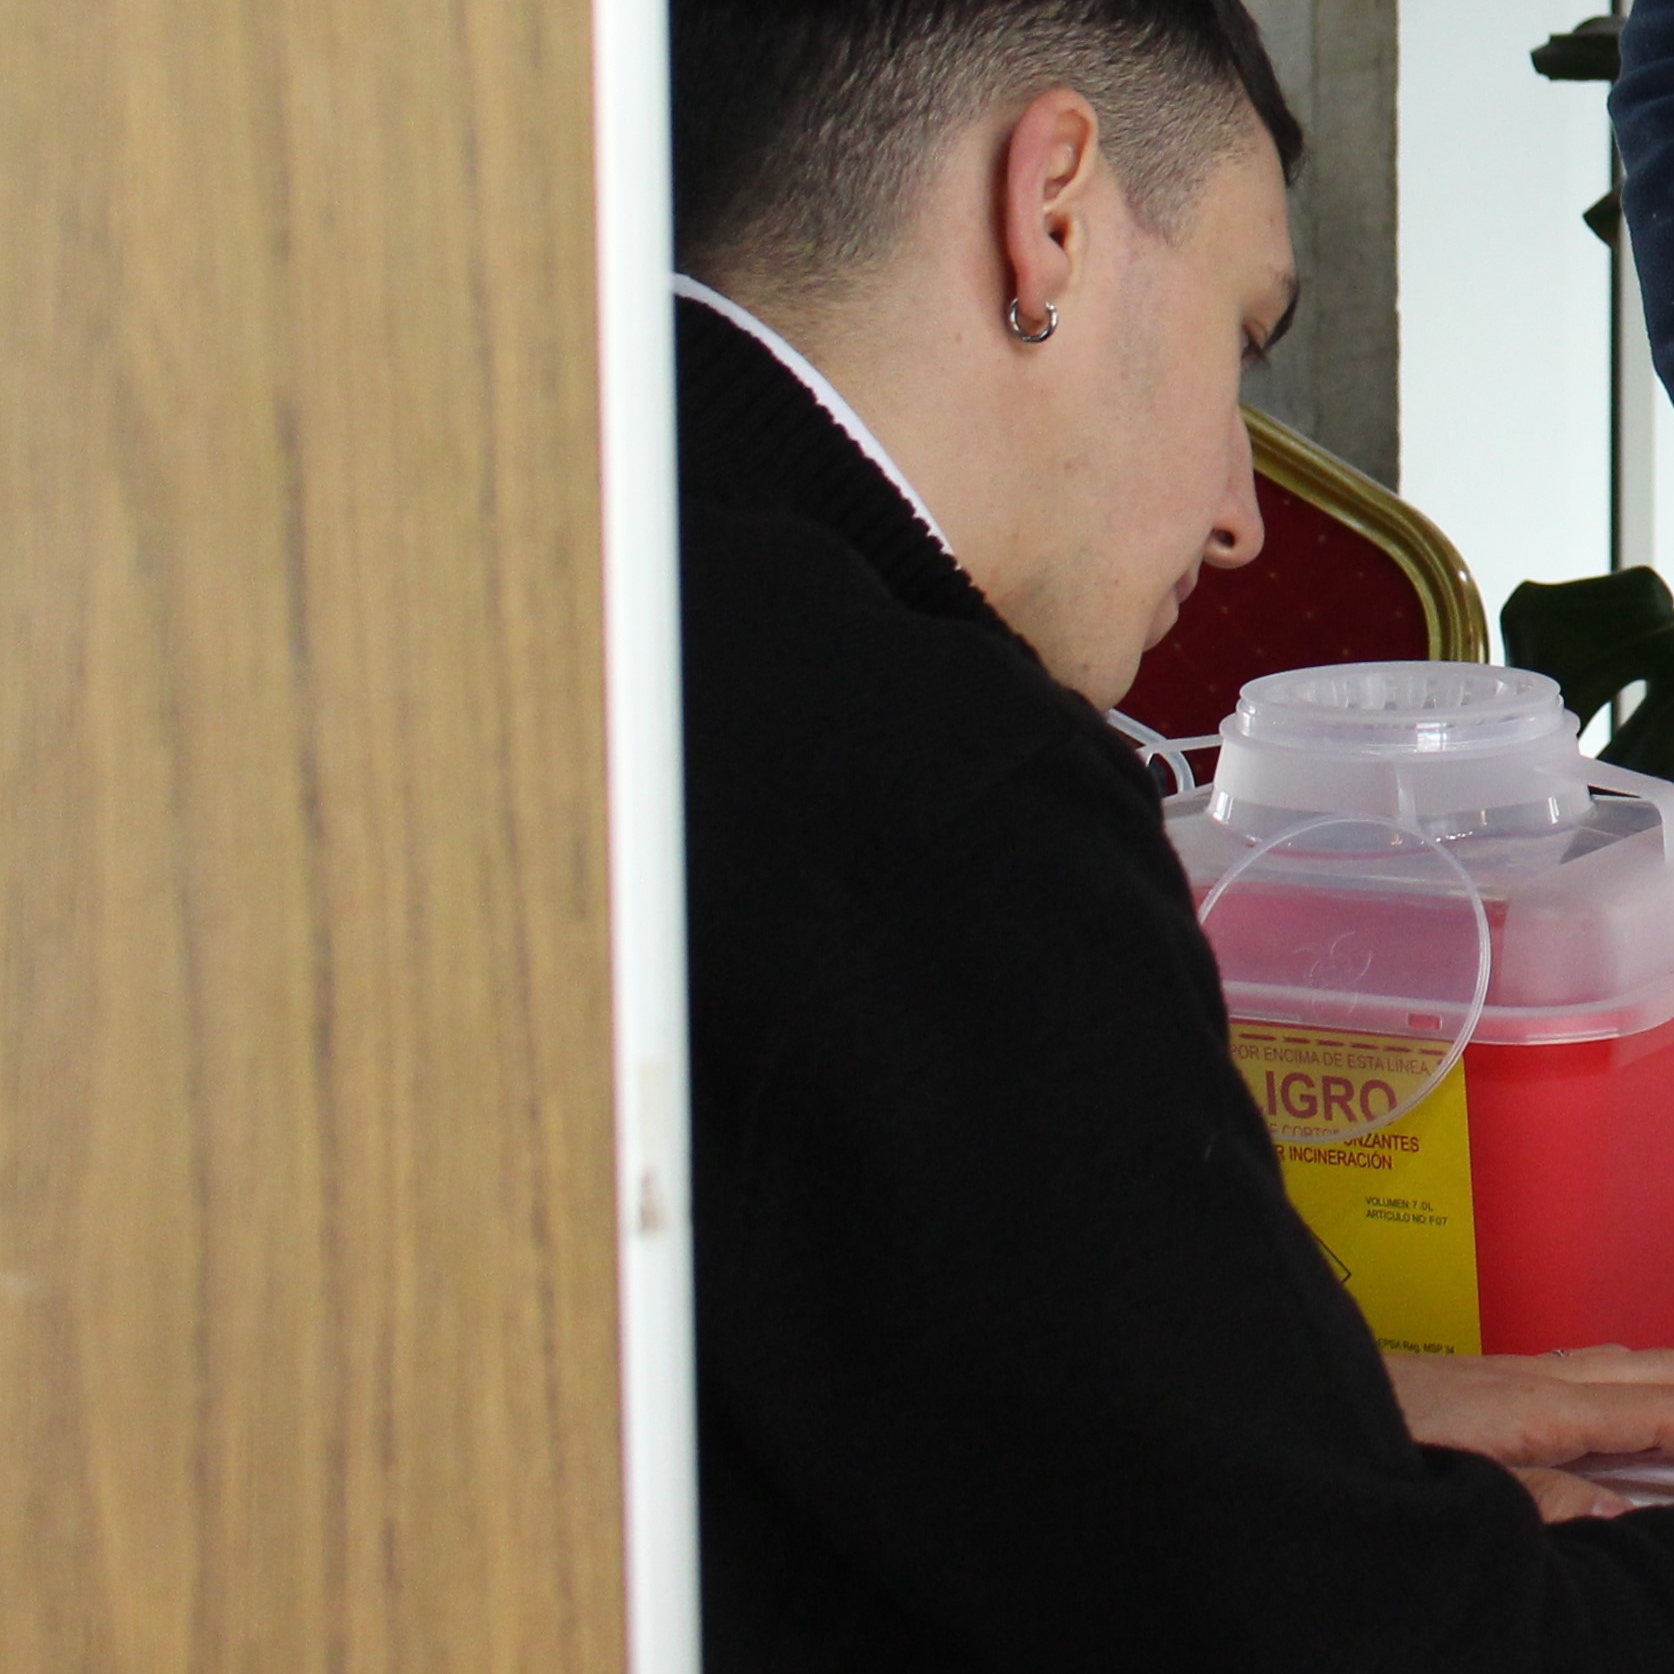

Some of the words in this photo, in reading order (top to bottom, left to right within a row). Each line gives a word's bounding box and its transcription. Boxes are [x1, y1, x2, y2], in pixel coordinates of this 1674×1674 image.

[1264, 1046, 1320, 1065] ENCIMA
[1323, 1052, 1343, 1068] DE
[1347, 1054, 1385, 1072] ESTA
[1289, 1146, 1393, 1170] INCINERACIÓN
